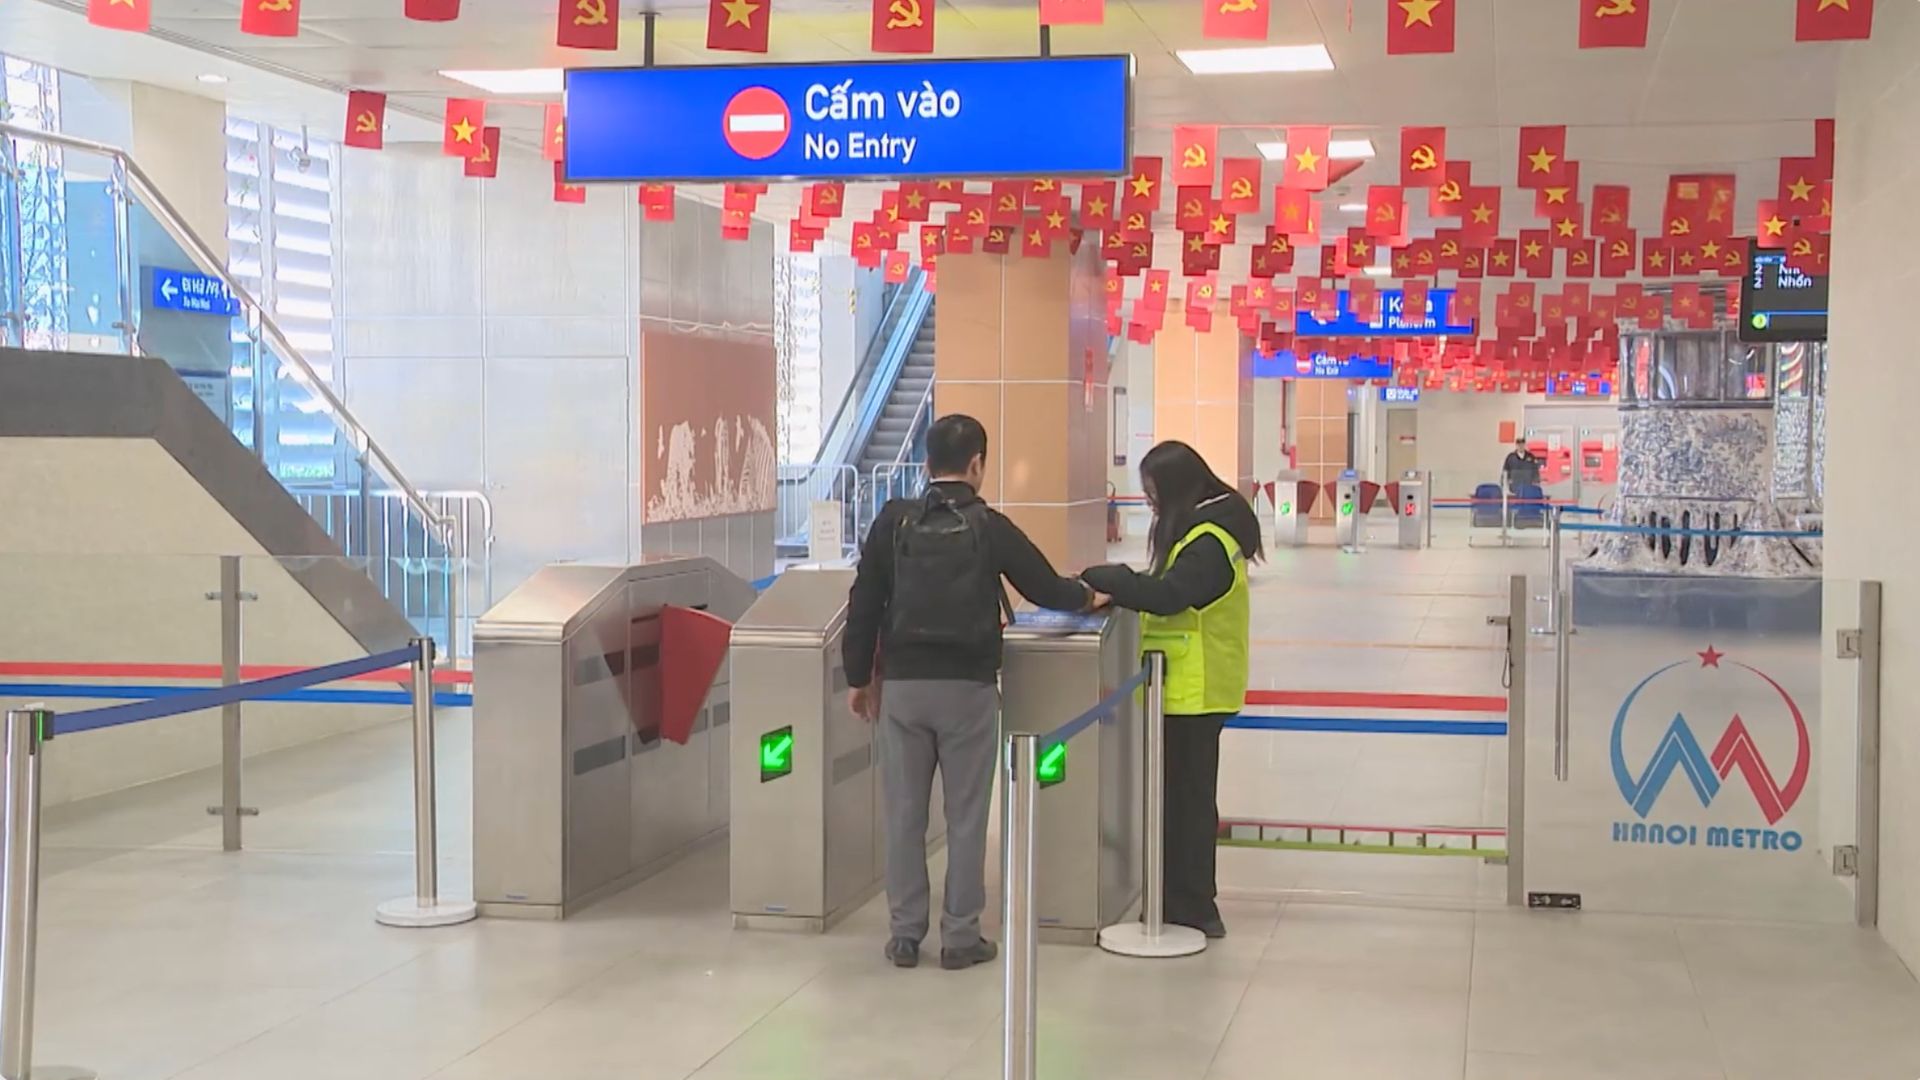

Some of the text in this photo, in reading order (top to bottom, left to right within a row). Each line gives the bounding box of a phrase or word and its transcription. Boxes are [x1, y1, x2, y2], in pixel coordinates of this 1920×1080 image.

[804, 79, 961, 121] Cấm vào
[804, 131, 917, 163] No Entry
[1612, 822, 1803, 852] HANOI METRO
